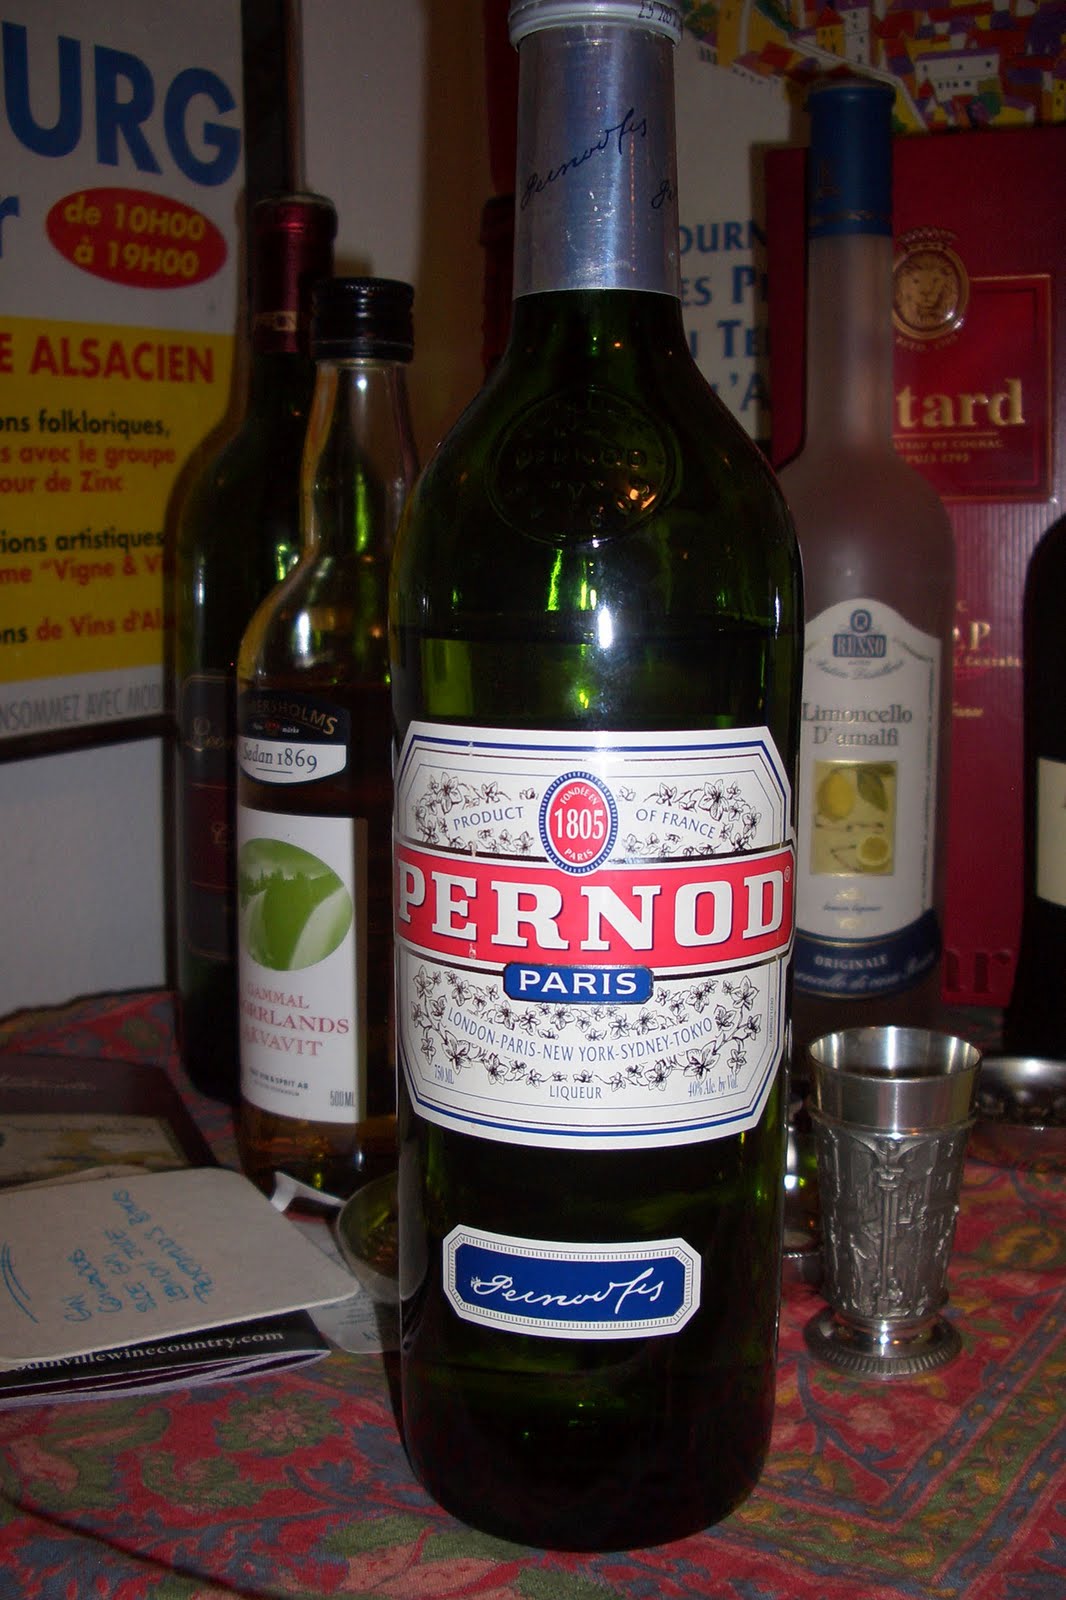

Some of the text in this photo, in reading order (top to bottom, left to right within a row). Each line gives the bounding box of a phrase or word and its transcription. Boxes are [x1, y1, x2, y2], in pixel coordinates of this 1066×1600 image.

[2, 21, 242, 187] URG
[64, 195, 206, 242] de 10H00
[74, 235, 199, 278] à 19H00
[29, 335, 215, 384] ALSACIEN
[894, 377, 1026, 429] tard
[19, 445, 70, 464] avec
[78, 439, 97, 464] le
[104, 446, 176, 469] groupe
[44, 469, 73, 493] de
[80, 470, 124, 494] Zinc
[122, 555, 137, 577] &
[36, 617, 63, 642] de
[69, 611, 115, 638] Vins
[802, 703, 913, 723] Limoncello
[243, 742, 273, 765] Sedan
[277, 747, 318, 774] 1869
[588, 793, 600, 805] EN
[453, 805, 716, 840] PRODUCT OF FRANCE
[554, 807, 605, 840] 1805
[564, 848, 594, 861] PARIS
[397, 860, 785, 952] PERNOD
[814, 953, 889, 970] ORIGINALE
[519, 969, 637, 995] PARIS
[549, 1085, 602, 1101] LIQUEUR
